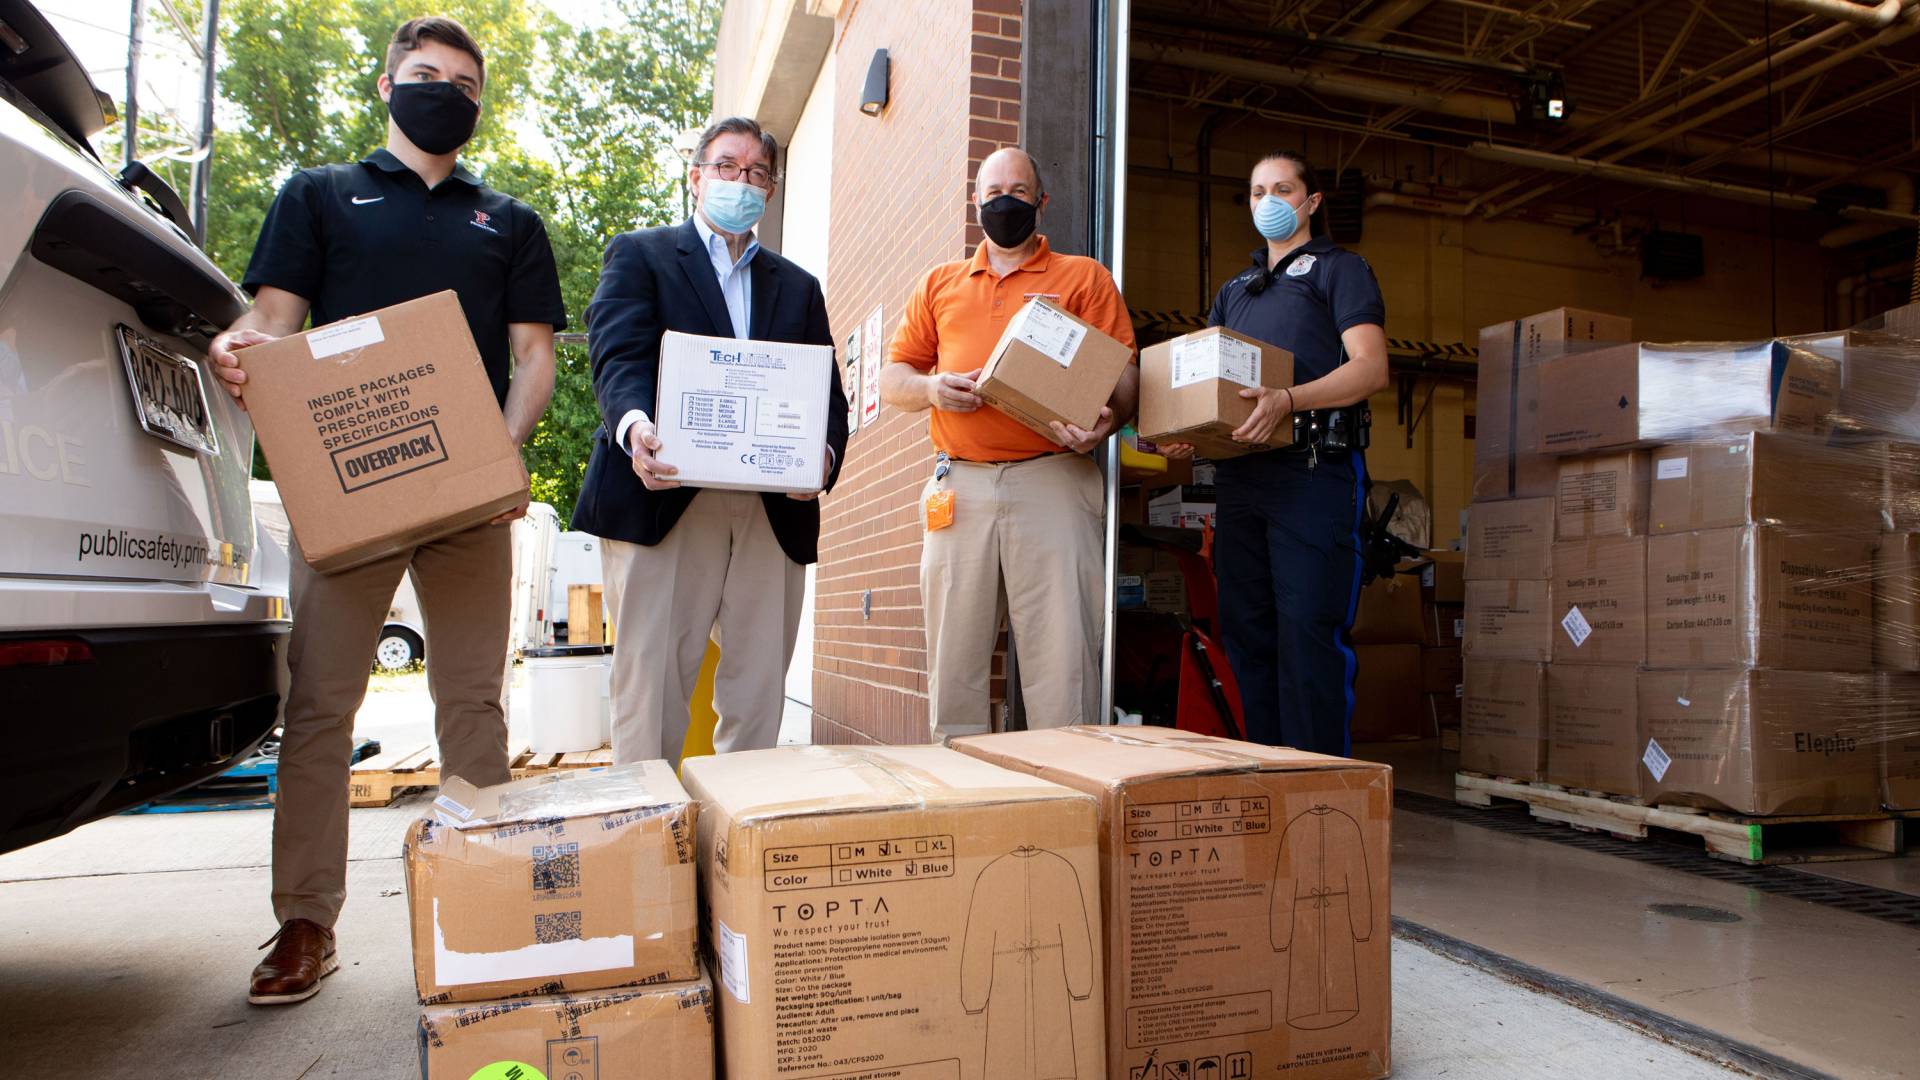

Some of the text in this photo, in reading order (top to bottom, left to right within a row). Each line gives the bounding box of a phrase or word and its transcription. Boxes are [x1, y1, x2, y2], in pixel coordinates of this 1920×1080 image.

[307, 363, 436, 411] INSIDE PACKAGES
[313, 385, 411, 424] COMPLY WITH
[318, 400, 410, 437] PRESCRIBED
[323, 405, 440, 450] SPECIFICATIONS
[0, 419, 92, 489] ICE
[344, 434, 436, 479] OVERPACK
[1130, 801, 1265, 818] Size M L XL
[1130, 820, 1266, 839] Color White Blue
[772, 841, 947, 864] Size M L XL
[1130, 847, 1220, 868] TOPTA
[773, 863, 949, 886] Color White Blue
[772, 897, 889, 923] TOPTA
[773, 919, 890, 937] We respect your trust
